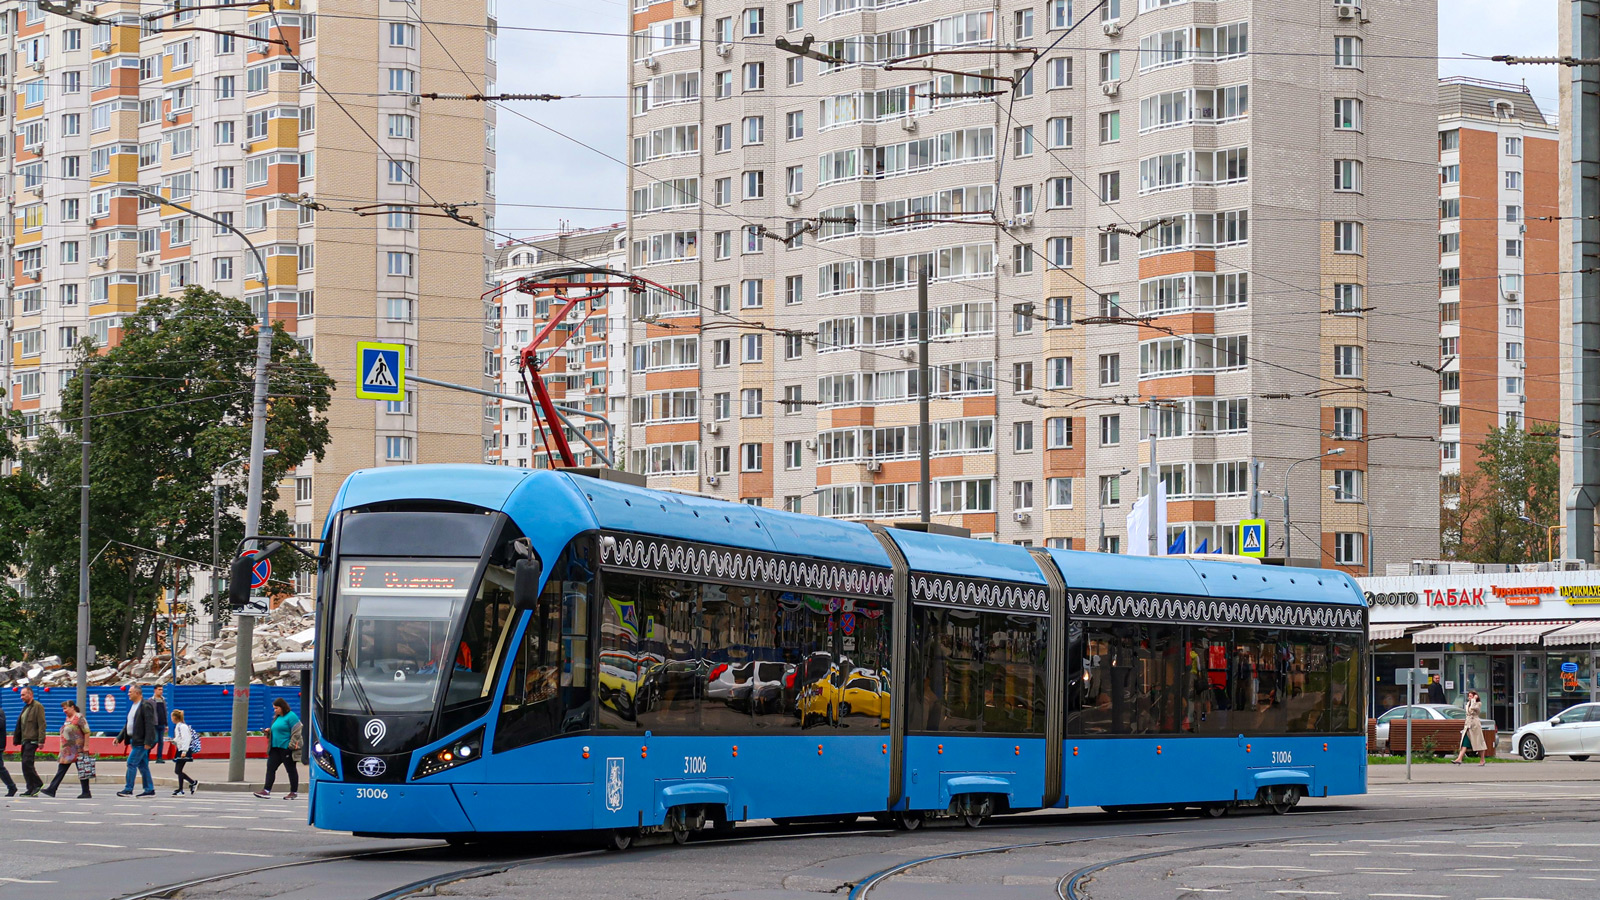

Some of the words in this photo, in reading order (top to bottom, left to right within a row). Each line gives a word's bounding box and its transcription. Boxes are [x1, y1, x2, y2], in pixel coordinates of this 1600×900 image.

[1375, 591, 1419, 606] ФОТО
[1423, 587, 1486, 606] ТАБАК
[1271, 750, 1292, 764] 31006
[683, 756, 707, 774] 31006
[356, 787, 389, 800] 31006
